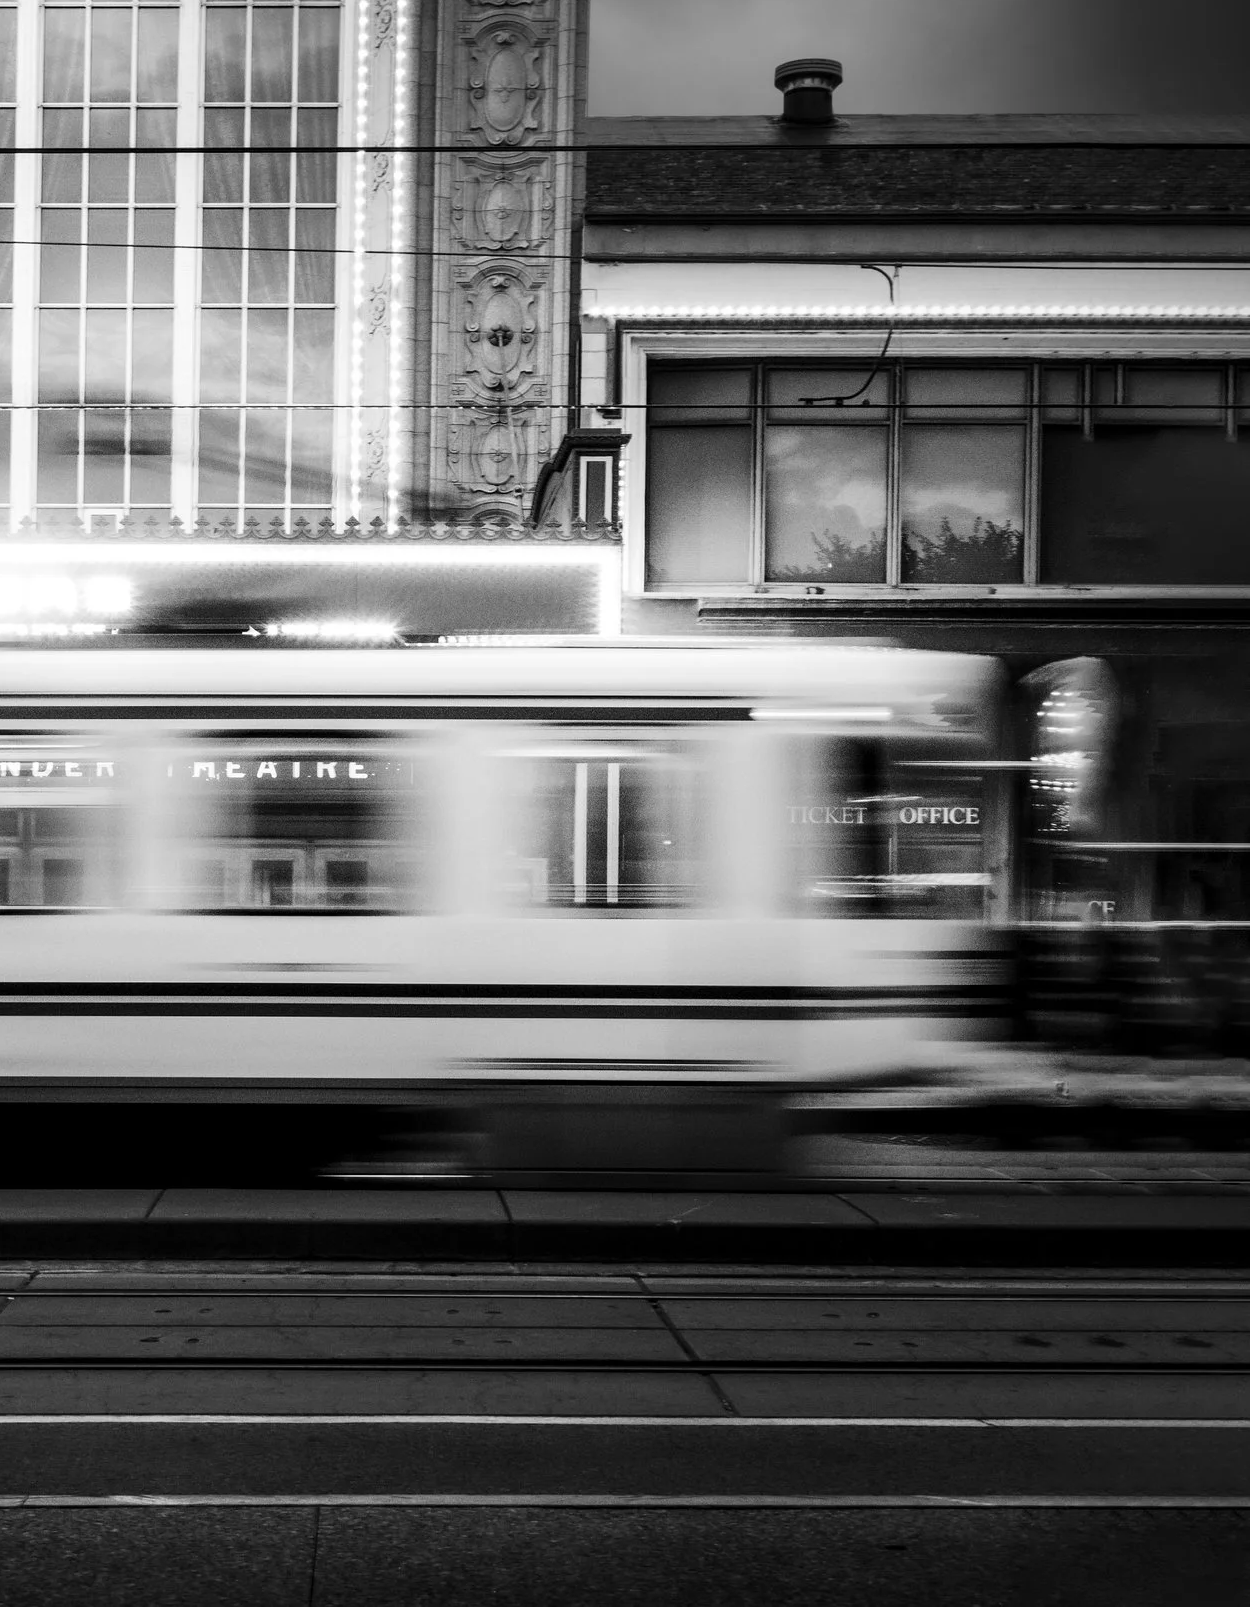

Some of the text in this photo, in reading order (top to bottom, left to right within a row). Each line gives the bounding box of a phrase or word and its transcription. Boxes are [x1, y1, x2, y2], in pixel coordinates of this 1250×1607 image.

[167, 762, 369, 779] HEATRE
[786, 806, 980, 825] TICKET OFFICE
